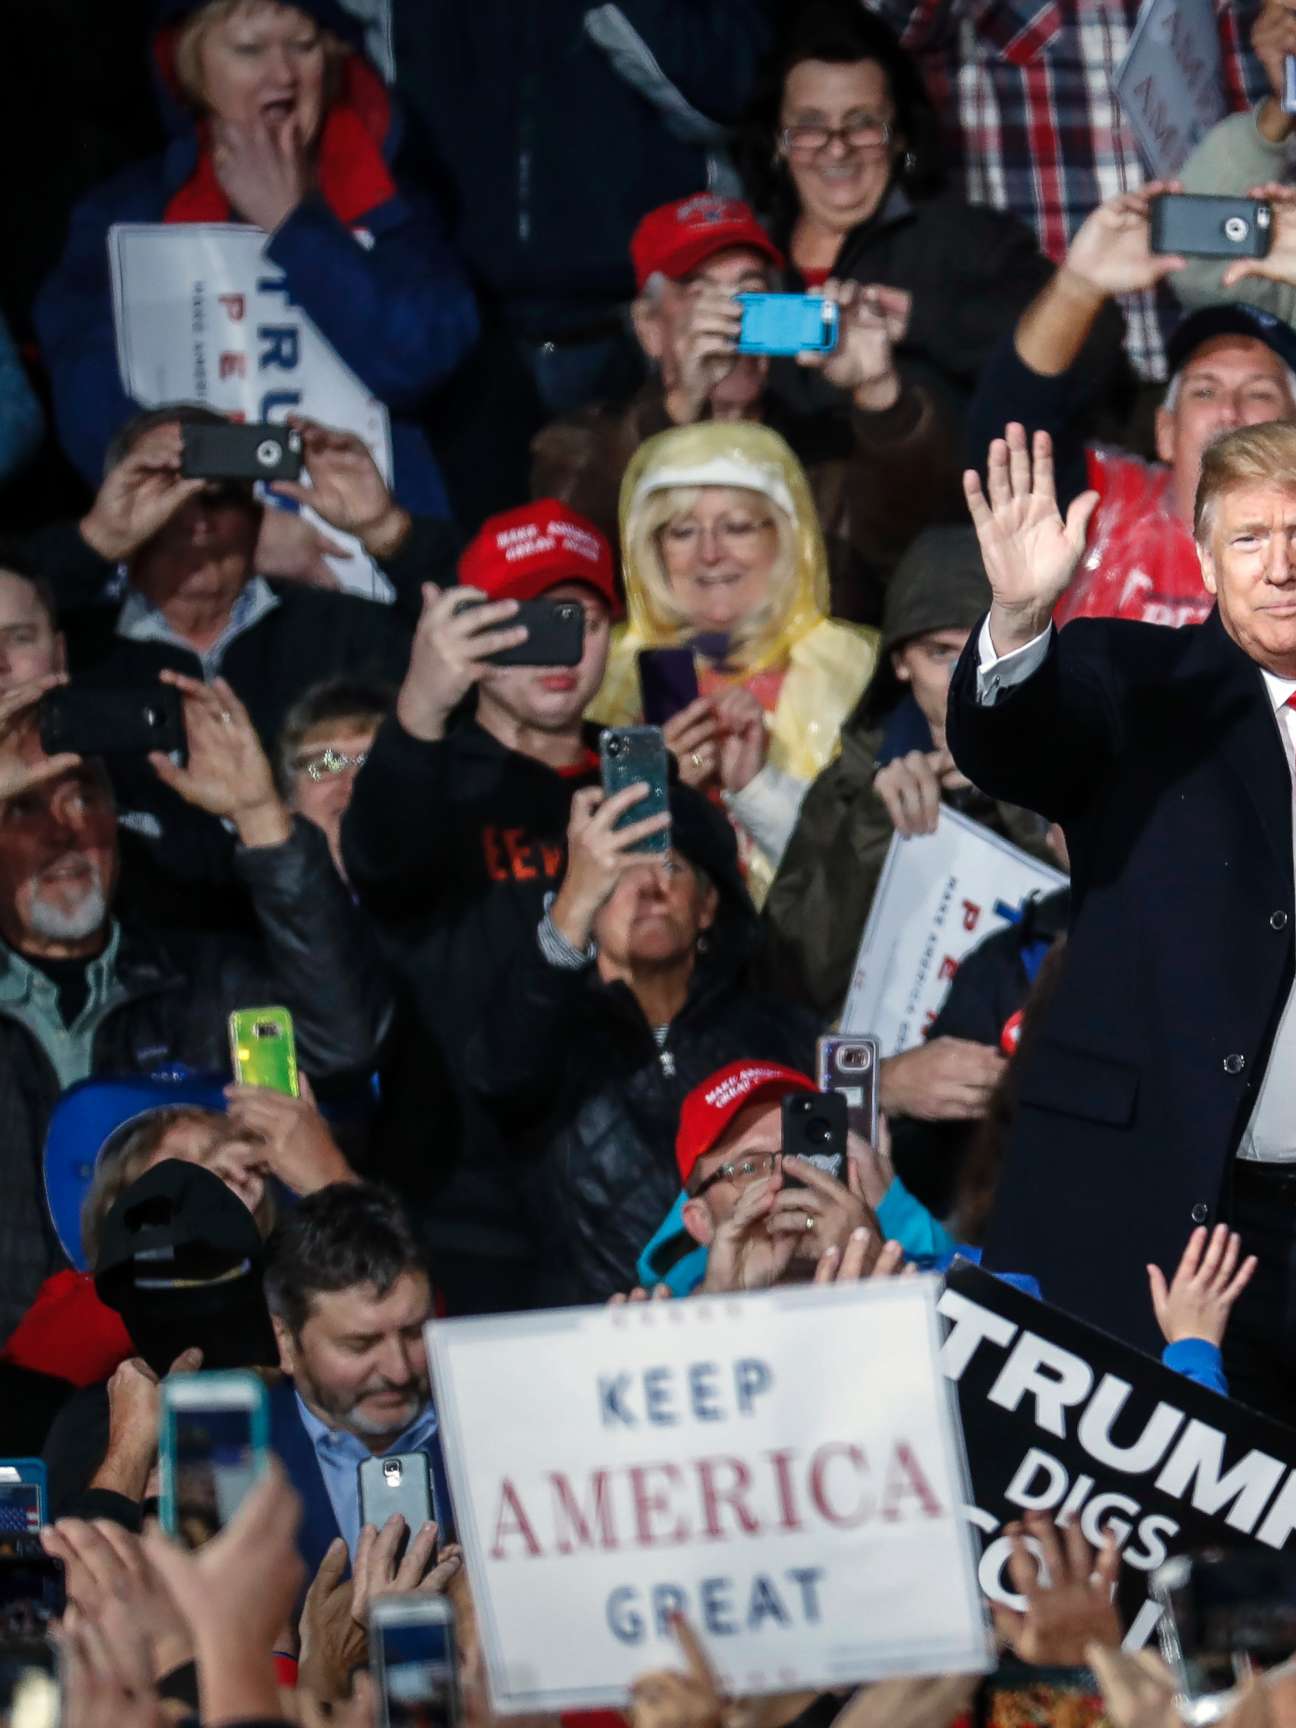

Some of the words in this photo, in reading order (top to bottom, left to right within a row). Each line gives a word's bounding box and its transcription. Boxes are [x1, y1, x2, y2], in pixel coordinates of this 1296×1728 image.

[596, 1356, 774, 1430] KEEP
[488, 1438, 944, 1562] AMERICA
[1003, 1446, 1182, 1572] DIGS
[605, 1567, 826, 1648] GREAT
